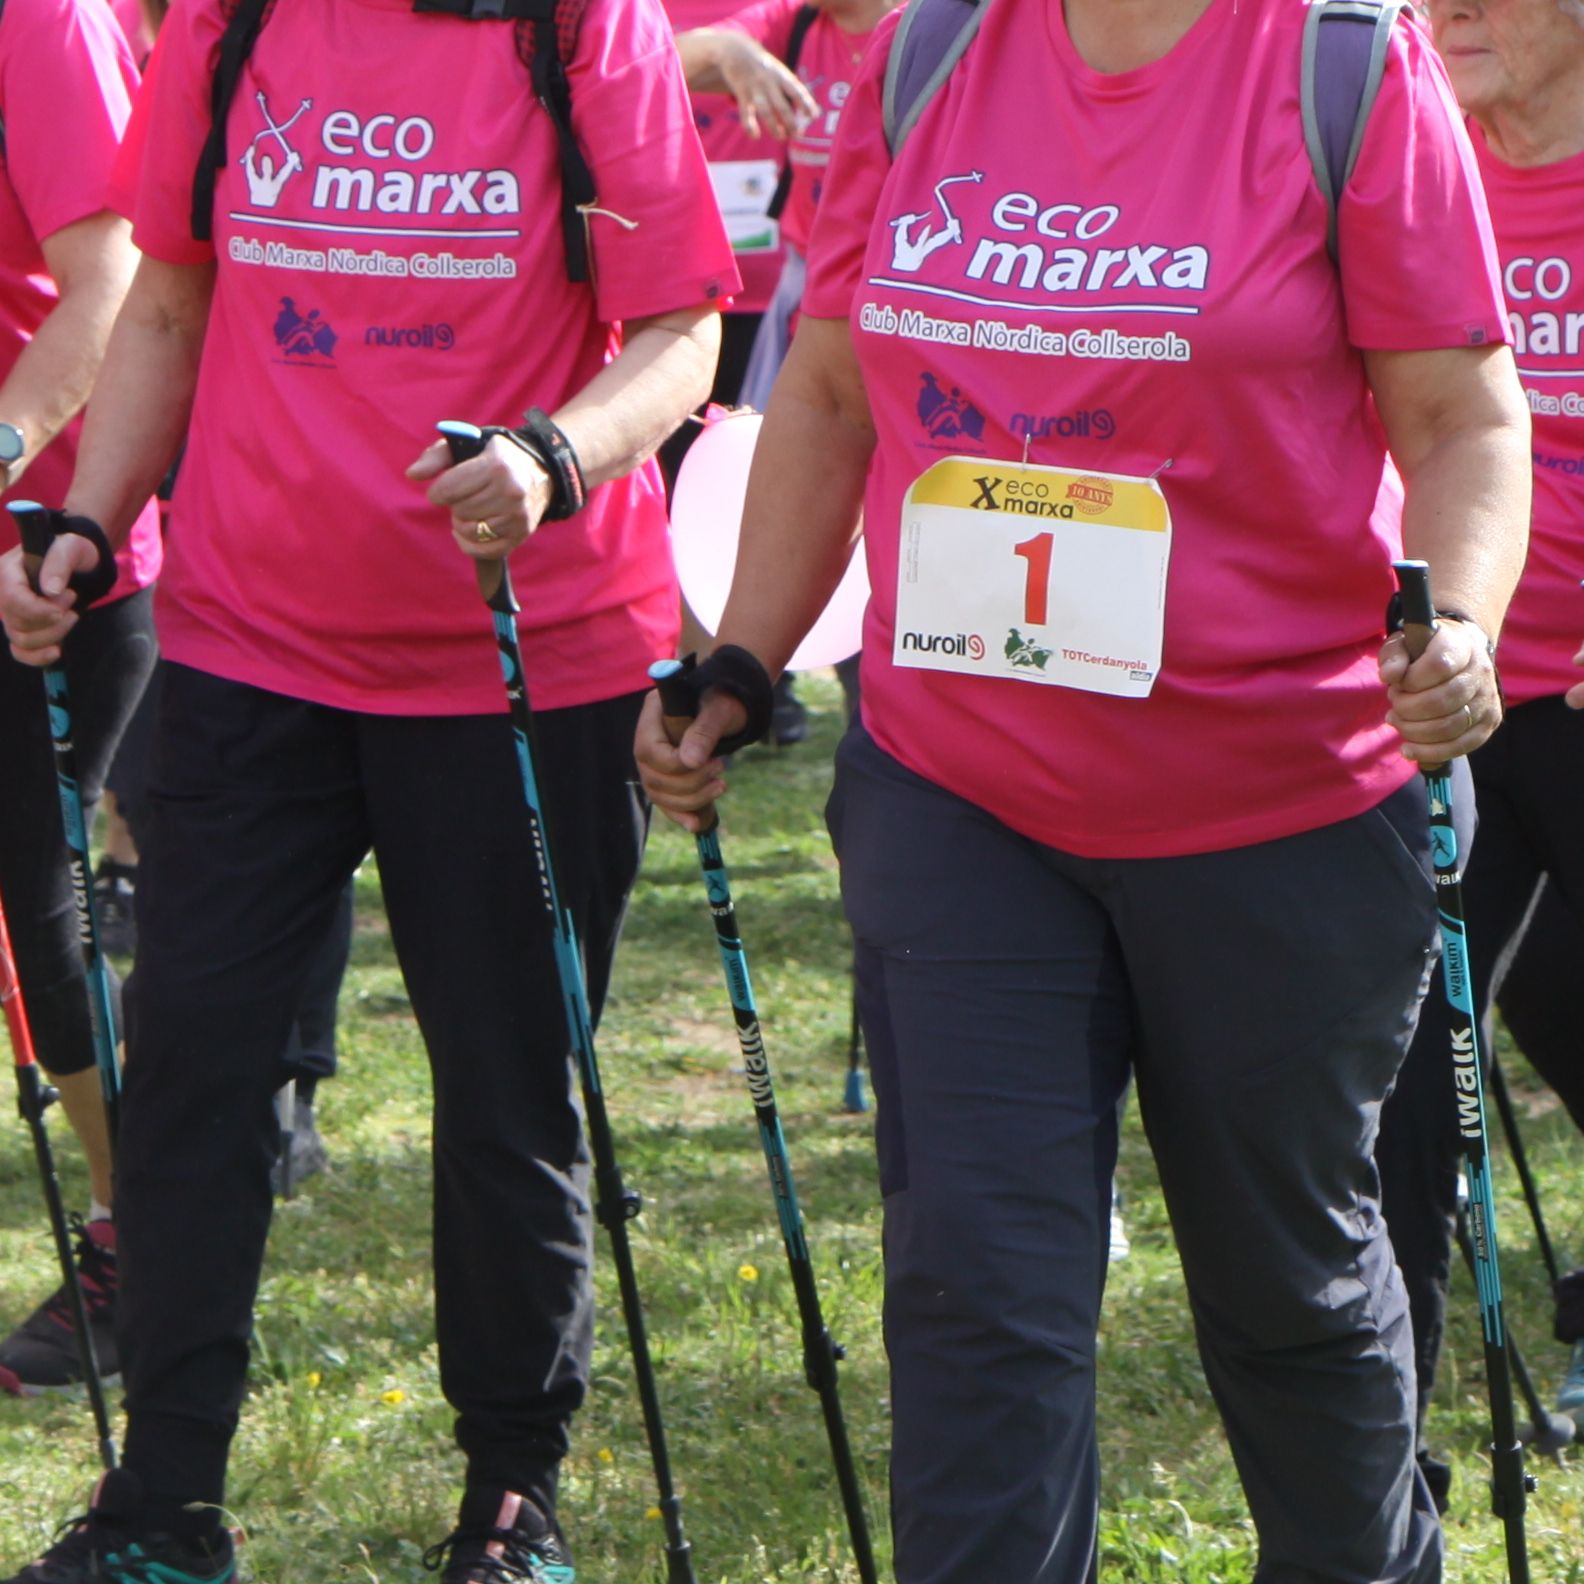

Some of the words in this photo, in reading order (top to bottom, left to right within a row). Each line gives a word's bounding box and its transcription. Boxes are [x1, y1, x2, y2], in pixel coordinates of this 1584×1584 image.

[321, 110, 435, 161] eco
[312, 164, 521, 215] marxa
[992, 190, 1121, 241] eco
[229, 236, 264, 262] Club
[266, 242, 325, 271] Marxa
[328, 248, 408, 277] Nòrdica
[410, 252, 516, 279] Collserola
[966, 237, 1211, 293] marxa
[1504, 257, 1571, 300] co
[365, 324, 434, 348] nuroil
[860, 303, 896, 334] Club
[899, 308, 969, 347] Marxa
[974, 320, 1066, 356] Nòrdica
[1069, 327, 1191, 362] Collserola
[1009, 412, 1091, 439] nuroil
[970, 476, 1003, 511] X
[1005, 480, 1050, 499] eco
[1003, 497, 1074, 519] marxa
[1070, 485, 1084, 497] 10
[1086, 489, 1113, 505] ANYS
[1013, 531, 1055, 626] 1
[902, 631, 966, 657] nuroil
[1062, 648, 1148, 671] TOTCerdanyola
[1447, 940, 1463, 998] walkim
[1450, 1027, 1483, 1140] iwalk
